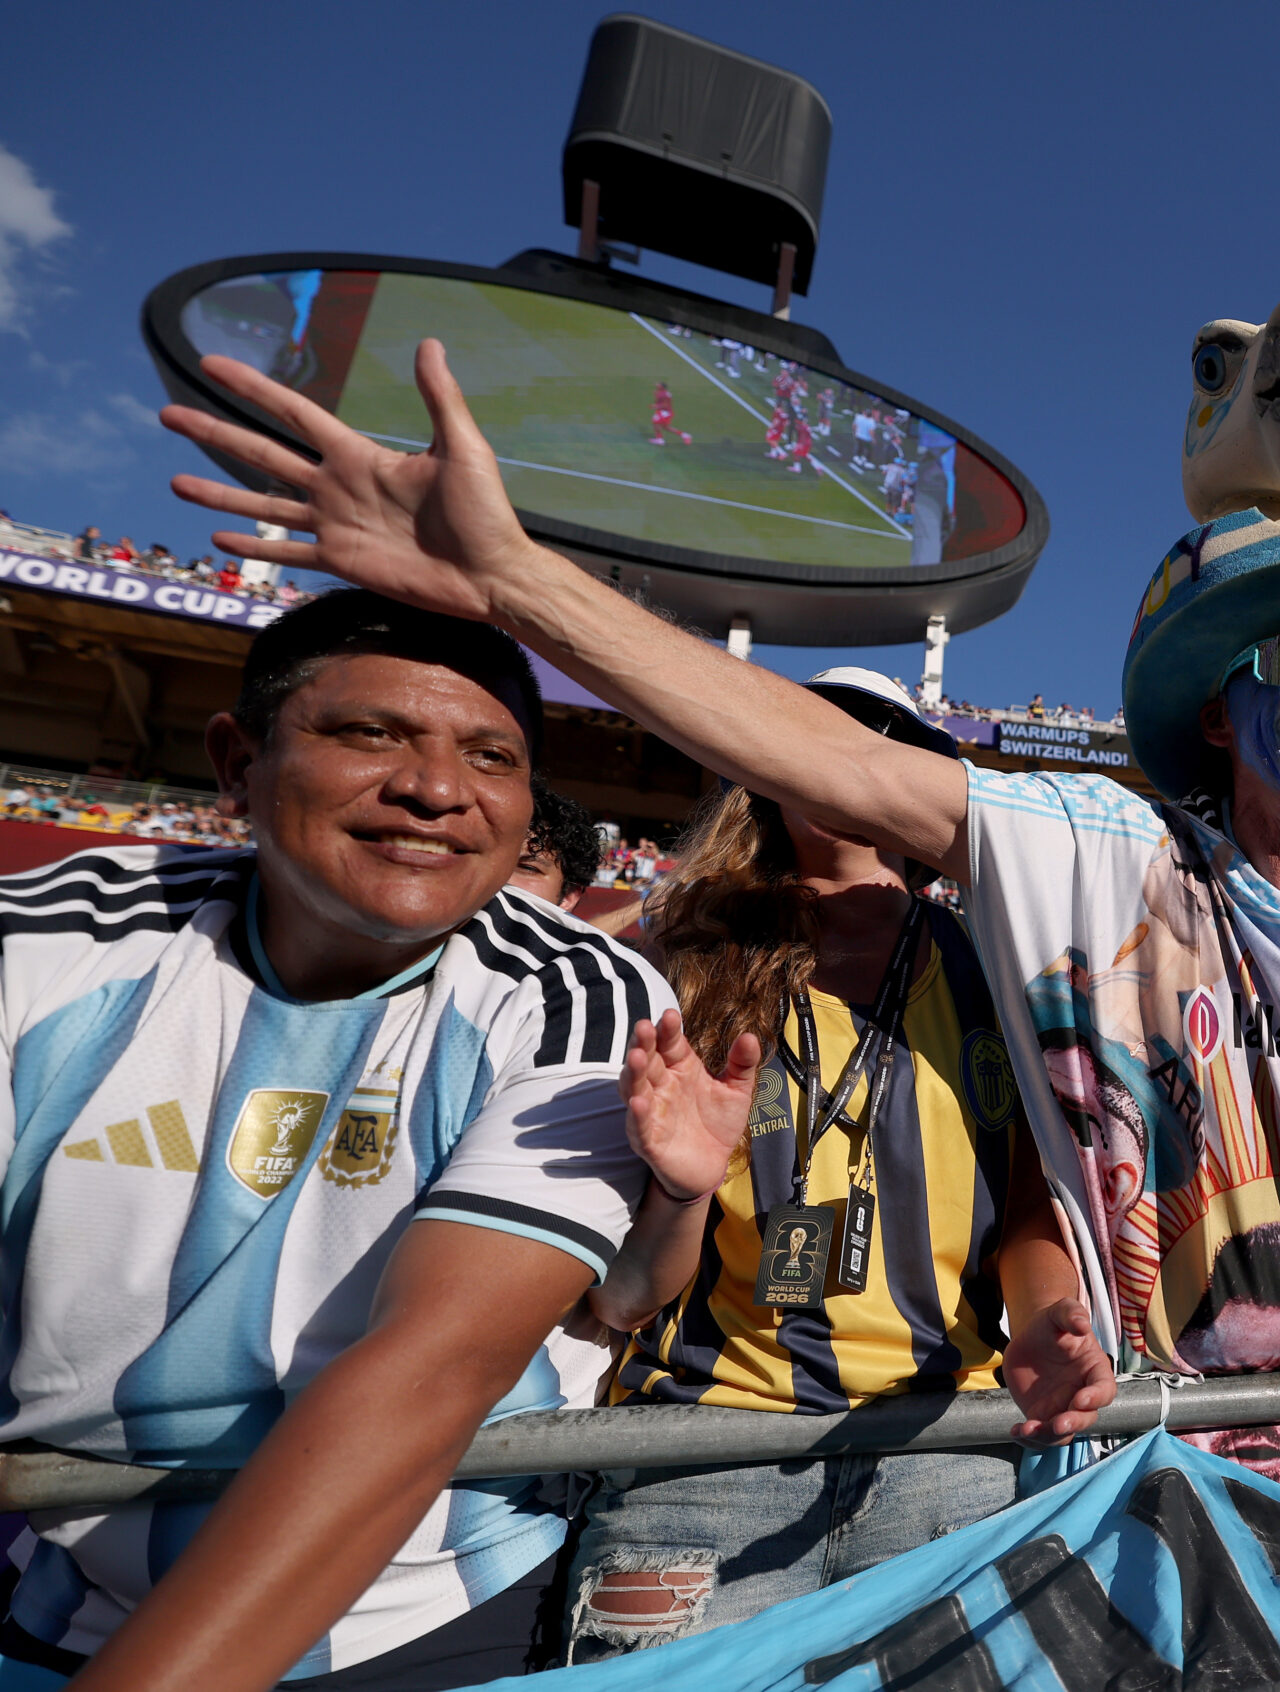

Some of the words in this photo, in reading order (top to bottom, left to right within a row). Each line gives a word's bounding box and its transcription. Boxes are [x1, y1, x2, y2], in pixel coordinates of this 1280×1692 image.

[153, 585, 245, 619] CUP
[1000, 722, 1090, 745] WARMUPS
[1000, 740, 1128, 766] SWITZERLAND!
[336, 1113, 378, 1160] AFA
[750, 1117, 790, 1138] ENTRAL
[254, 1156, 294, 1170] FIFA
[257, 1175, 283, 1184] 2022
[781, 1269, 801, 1277] FIFA
[765, 1293, 809, 1304] 2026
